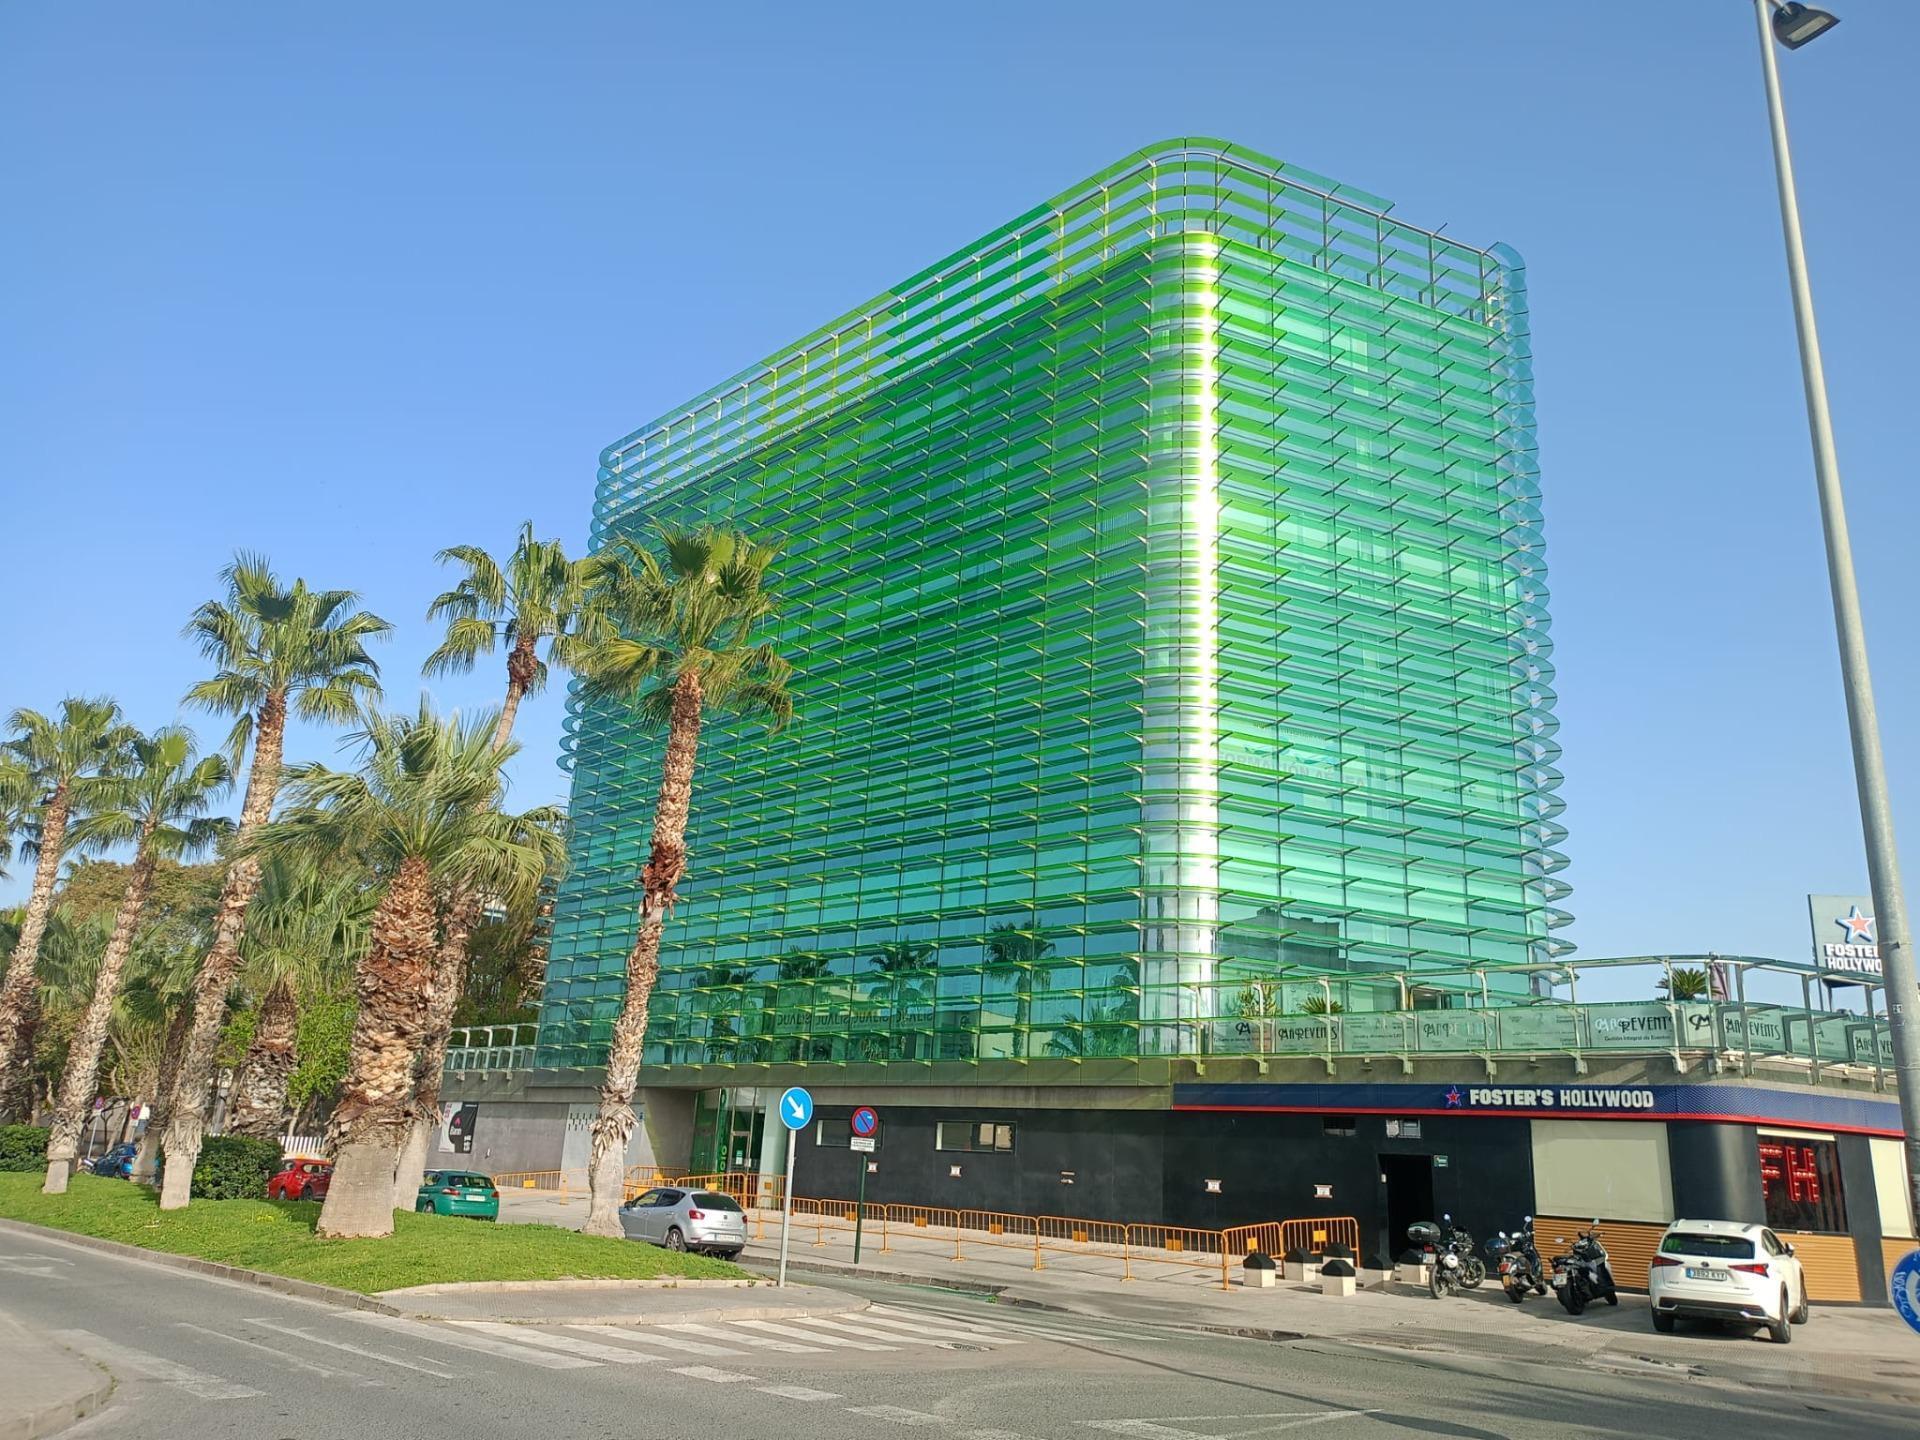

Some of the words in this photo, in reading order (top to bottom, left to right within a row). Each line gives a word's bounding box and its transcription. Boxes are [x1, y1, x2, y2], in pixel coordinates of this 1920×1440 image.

[1824, 944, 1879, 958] FOSTE
[1826, 958, 1883, 973] HOLLYWO
[1470, 1088, 1554, 1107] FOSTER'S
[1560, 1089, 1654, 1108] HOLLYWOOD
